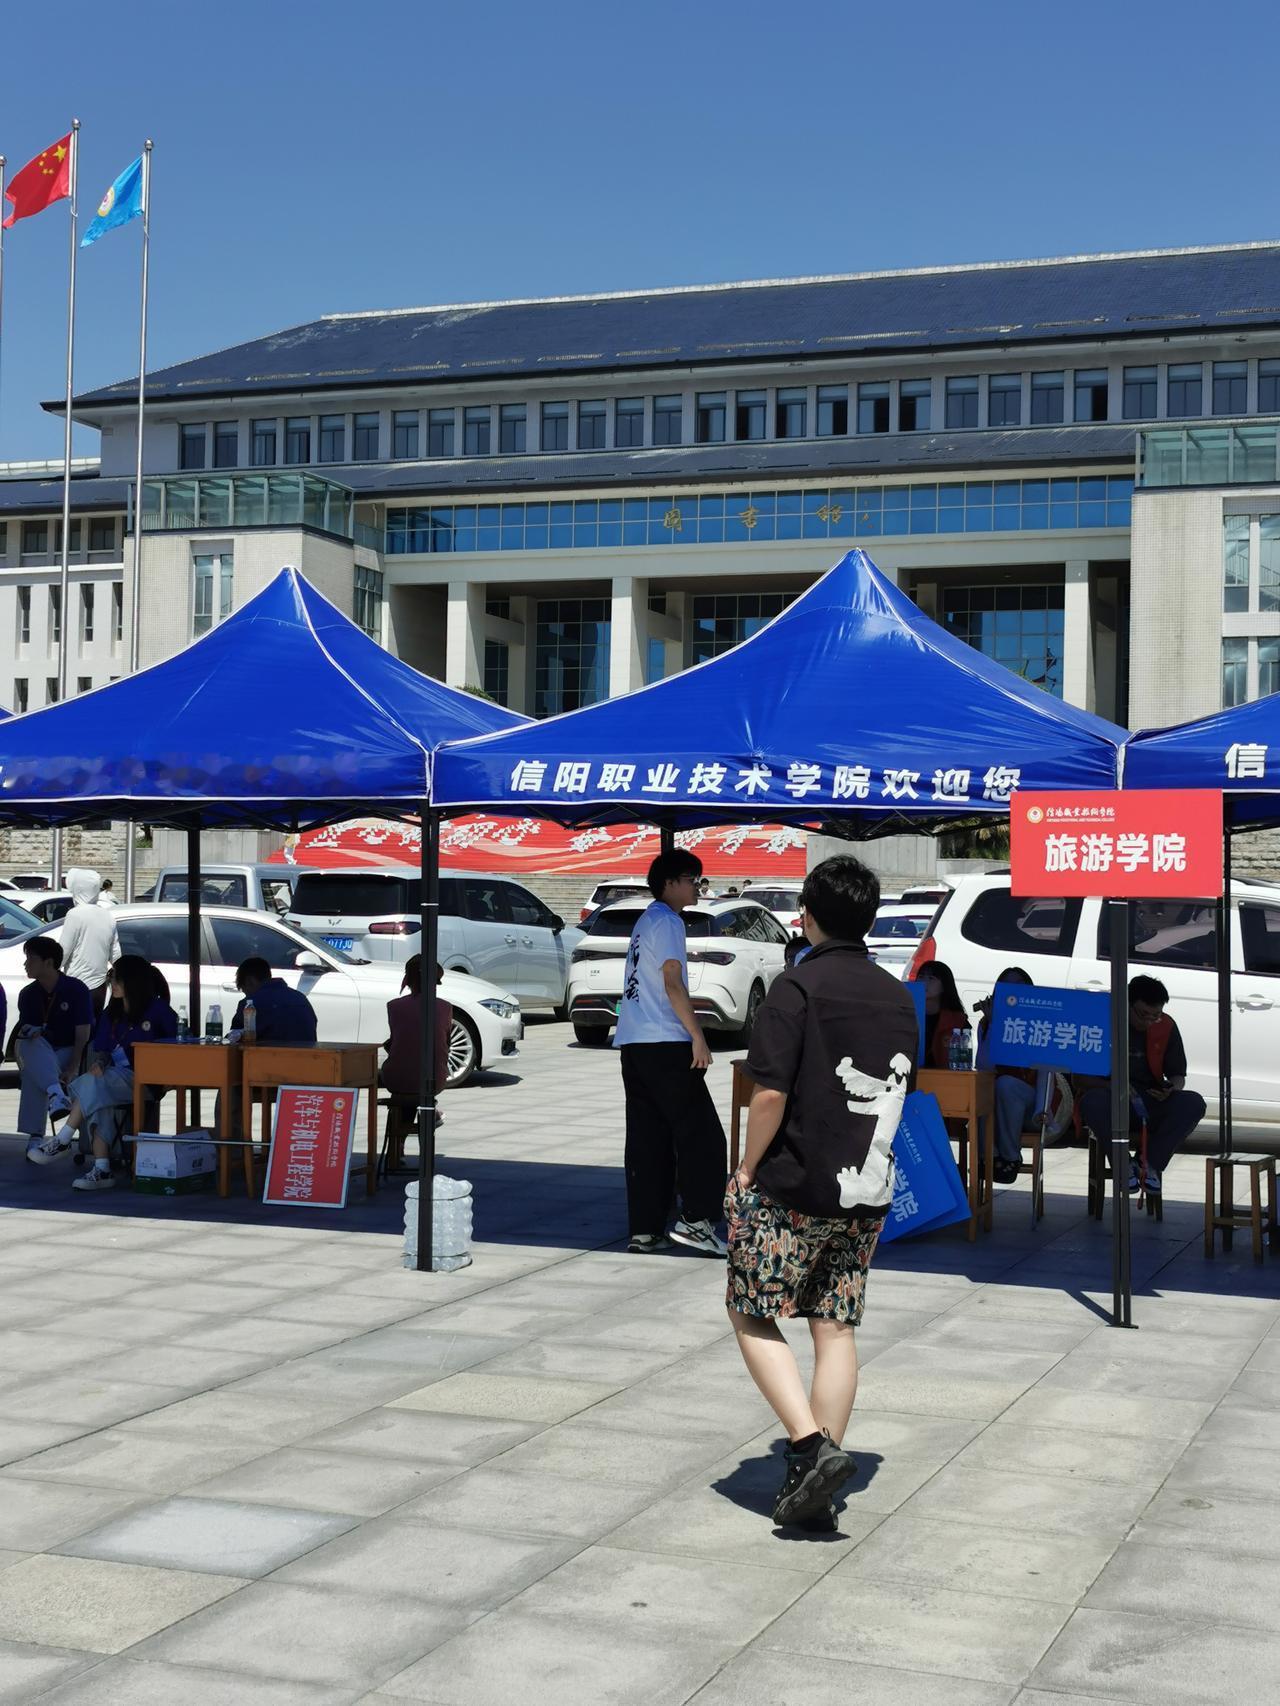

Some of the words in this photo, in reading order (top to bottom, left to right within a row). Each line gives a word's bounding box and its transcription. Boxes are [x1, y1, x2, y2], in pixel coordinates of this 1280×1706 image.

[510, 759, 1021, 803] 信阳职业技术学院欢迎您
[1225, 743, 1269, 778] 信
[1044, 833, 1187, 873] 旅游学院
[1002, 1017, 1104, 1053] 旅游学院
[283, 1094, 325, 1199] 汽车与机电工程学院
[891, 1156, 919, 1223] 学院
